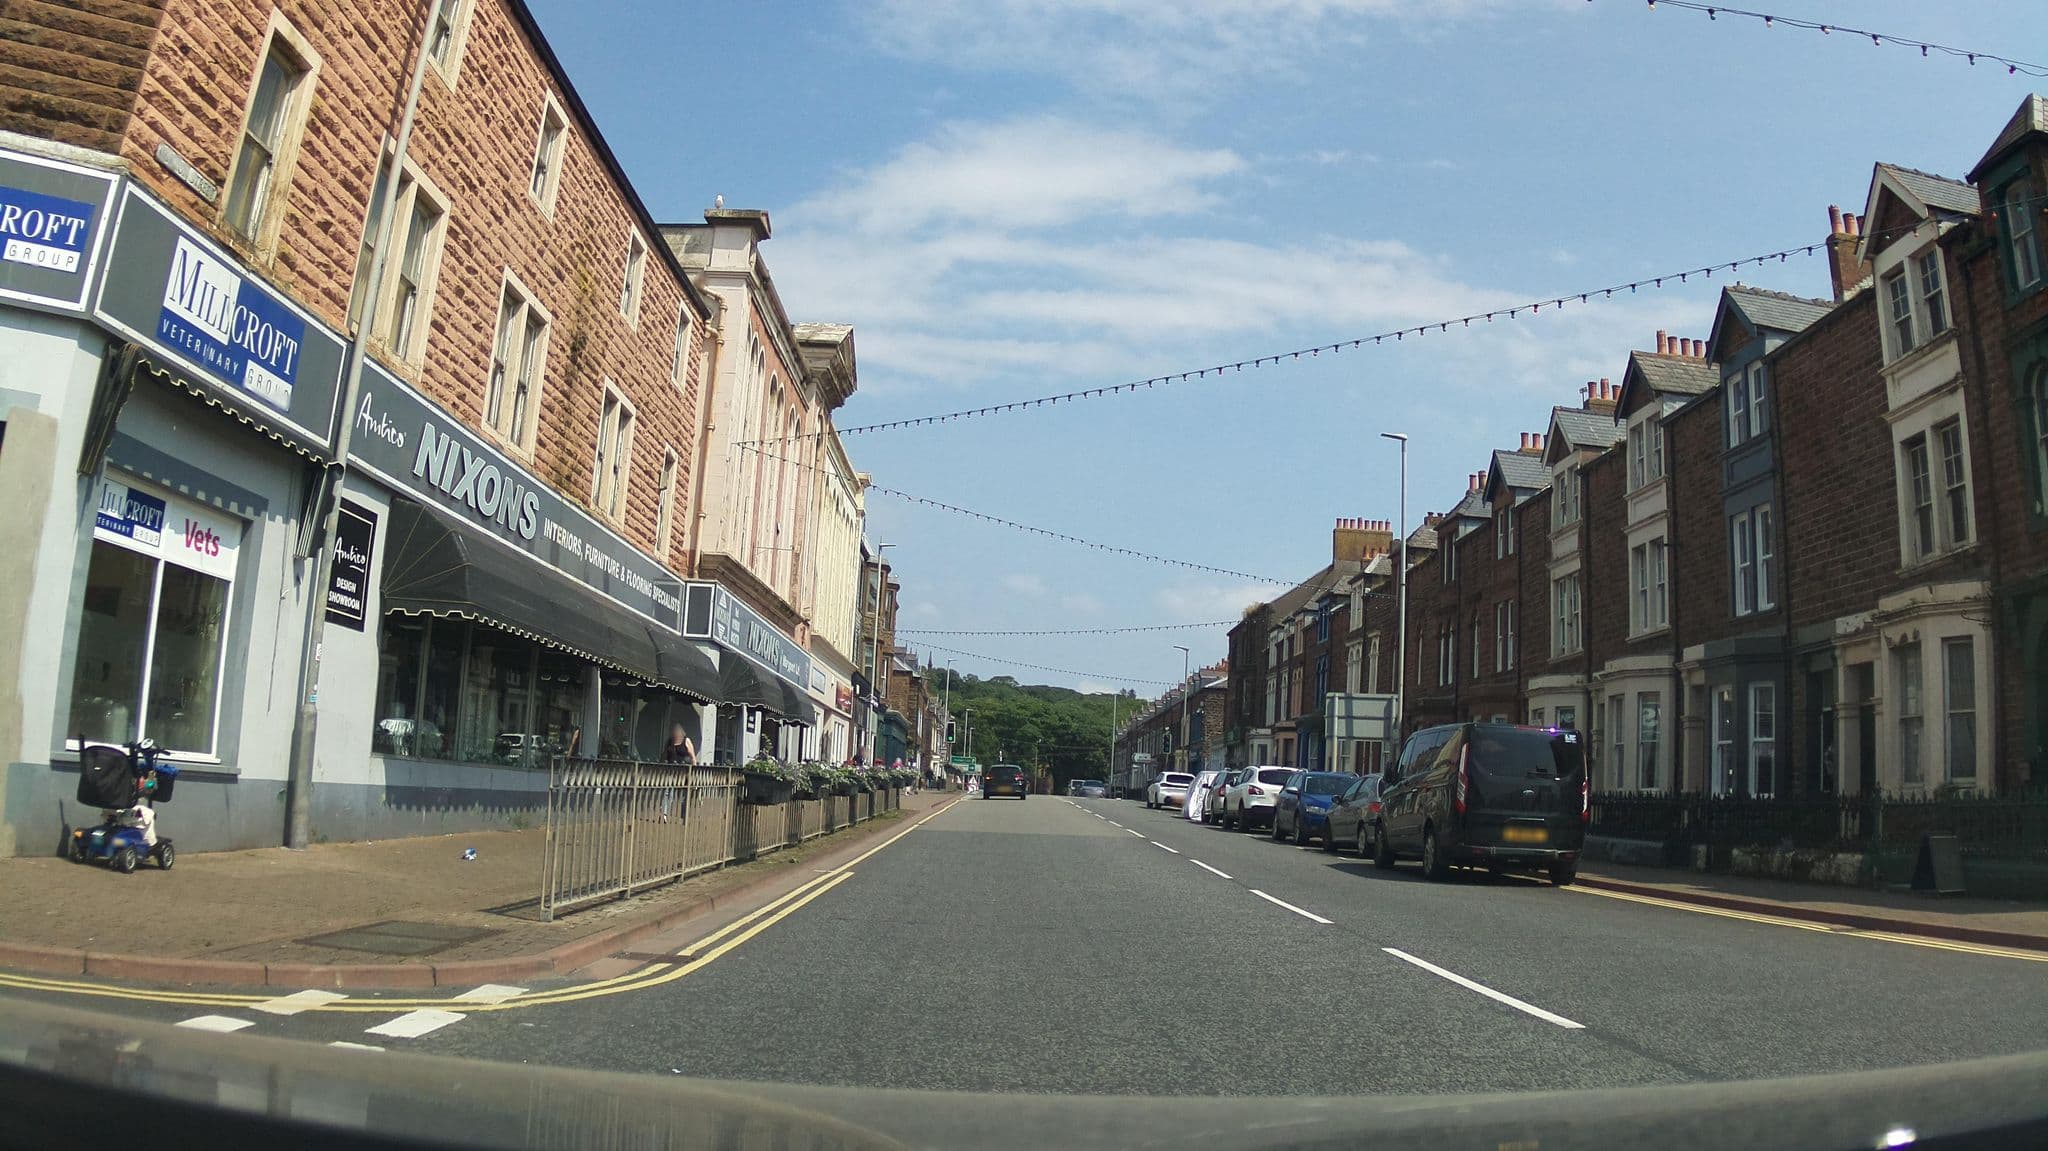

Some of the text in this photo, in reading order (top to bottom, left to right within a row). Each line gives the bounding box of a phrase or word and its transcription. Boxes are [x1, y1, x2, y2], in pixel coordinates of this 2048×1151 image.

[9, 244, 74, 268] GROUP
[169, 247, 298, 376] MILLCROFT
[162, 318, 240, 376] VETERINARY
[356, 392, 680, 614] Amtico NIXONS INTERIORS, FURNITURE & FLOORING SPECIALISTS
[185, 518, 220, 557] Vets
[328, 590, 360, 611] SHOWROOM
[336, 577, 357, 593] DESIGN
[747, 620, 780, 666] NIXONS
